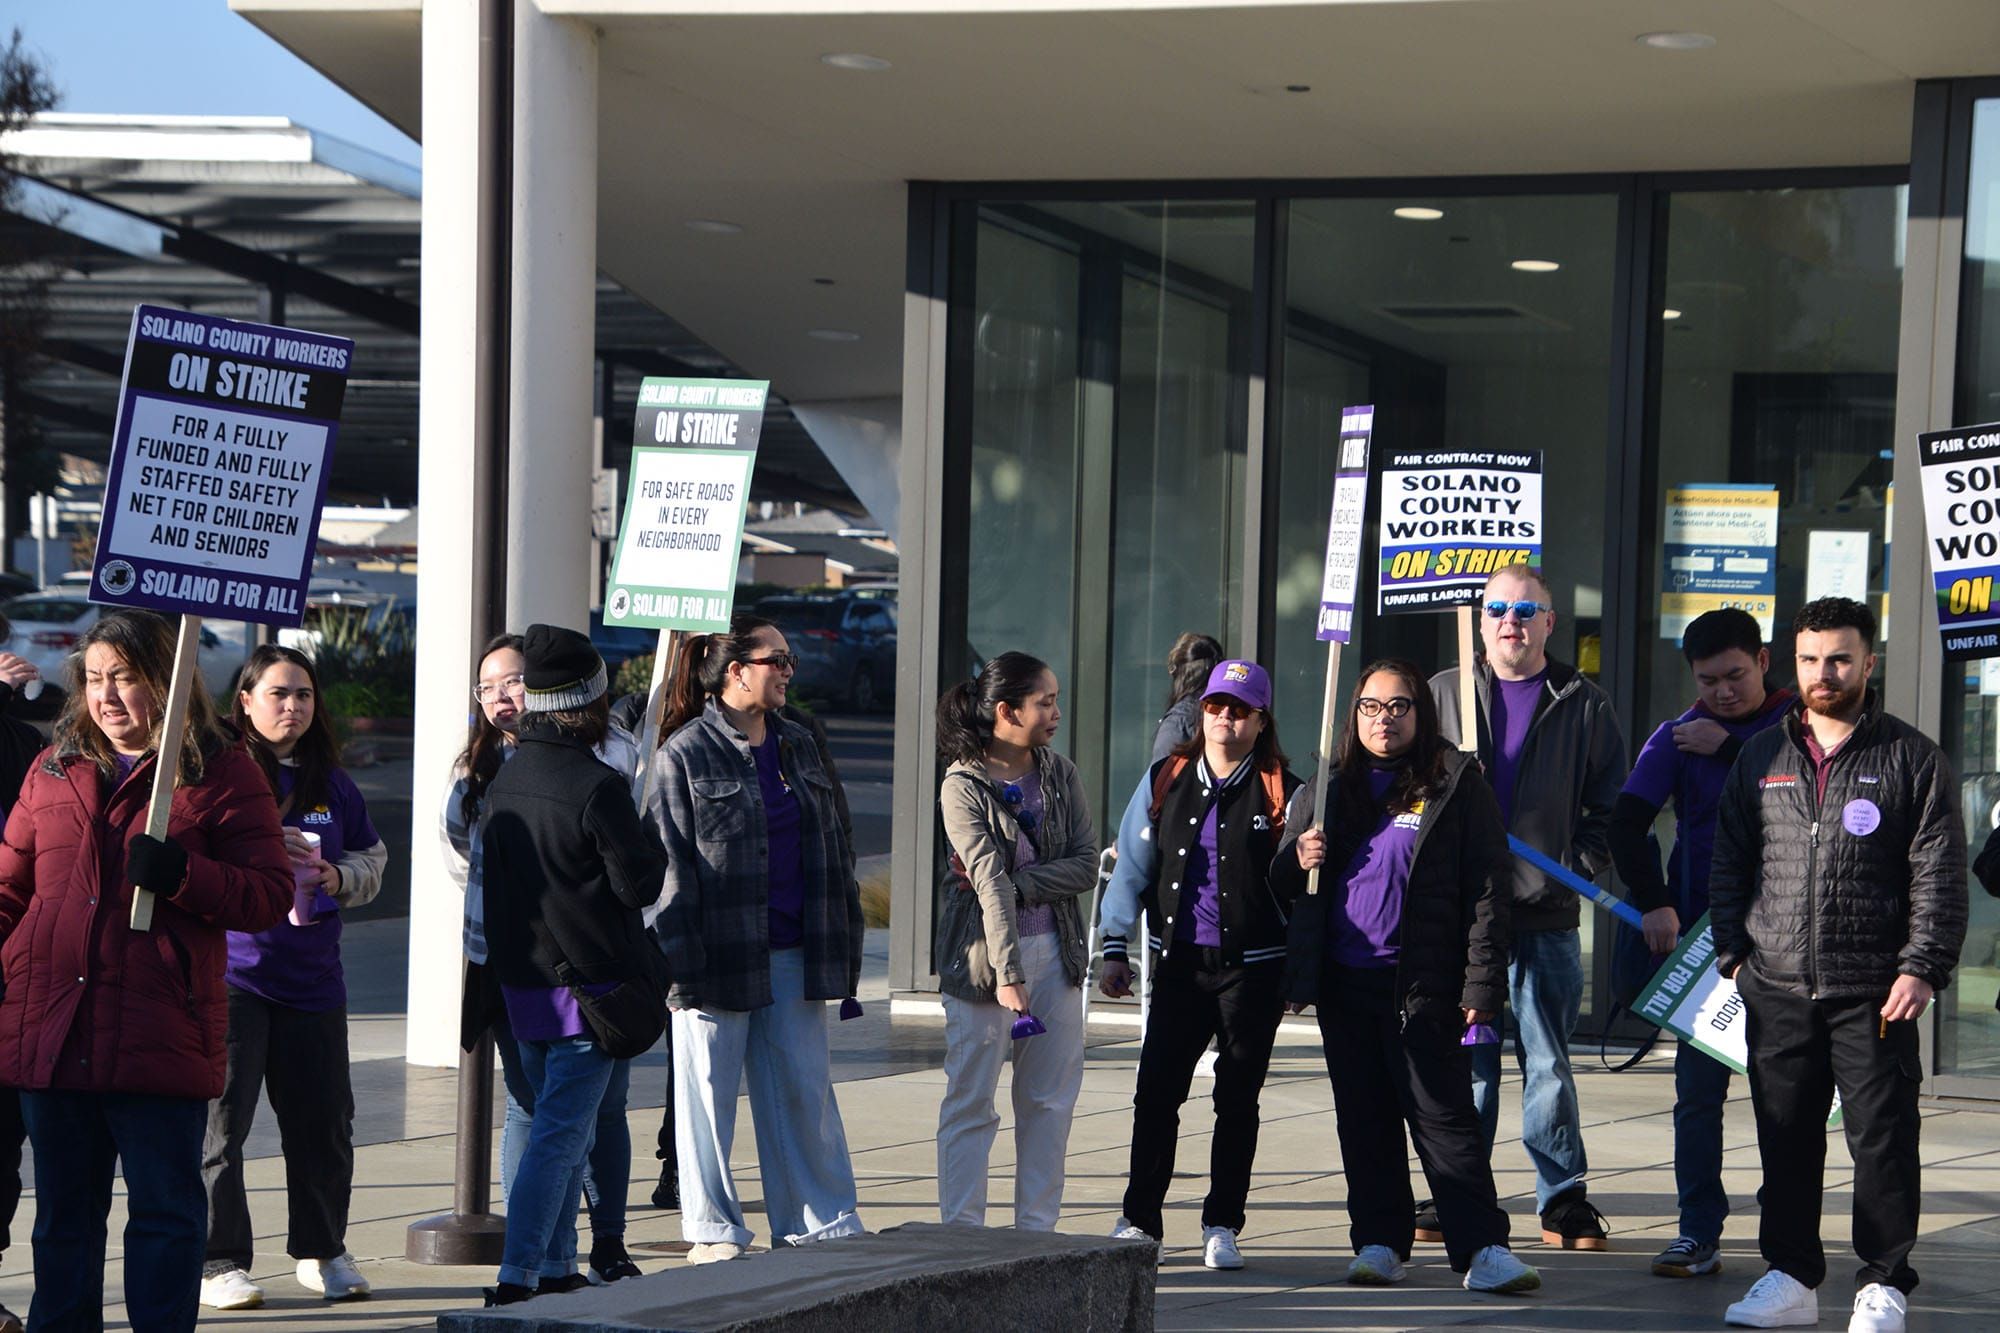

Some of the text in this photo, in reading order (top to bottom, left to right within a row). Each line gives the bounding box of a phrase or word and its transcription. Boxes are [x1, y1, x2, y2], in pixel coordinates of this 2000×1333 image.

[140, 315, 348, 369] SOLANO COUNTY WORKERS
[168, 352, 311, 409] ON STRIKE
[641, 384, 764, 407] SOLANO COUNTY WORKERS
[172, 414, 289, 451] FOR A FULLY
[655, 411, 739, 445] ON STRIKE
[136, 437, 312, 483] FUNDED AND FULLY
[1394, 453, 1532, 467] FAIR CONTRACT NOW
[1931, 438, 1965, 455] FAIR
[140, 466, 299, 509] STAFFED SAFETY
[641, 480, 735, 502] FOR SAFE ROADS
[1402, 474, 1521, 493] SOLANO
[129, 492, 299, 536] NET FOR CHILDREN
[658, 506, 709, 525] IN EVERY
[1400, 496, 1522, 515] COUNTY
[150, 524, 270, 559] AND SENIORS
[637, 531, 721, 551] NEIGHBORHOOD
[1387, 519, 1536, 539] WORKERS
[1390, 550, 1431, 579] ON
[140, 568, 299, 615] SOLANO FOR ALL
[1384, 592, 1429, 605] UNFAIR
[1431, 588, 1472, 601] LABOR
[1949, 576, 1993, 615] ON
[632, 593, 727, 622] SOLANO FOR ALL
[1947, 634, 1998, 650] UNFAIR
[1661, 964, 1694, 994] FOR
[1642, 990, 1674, 1017] ALL
